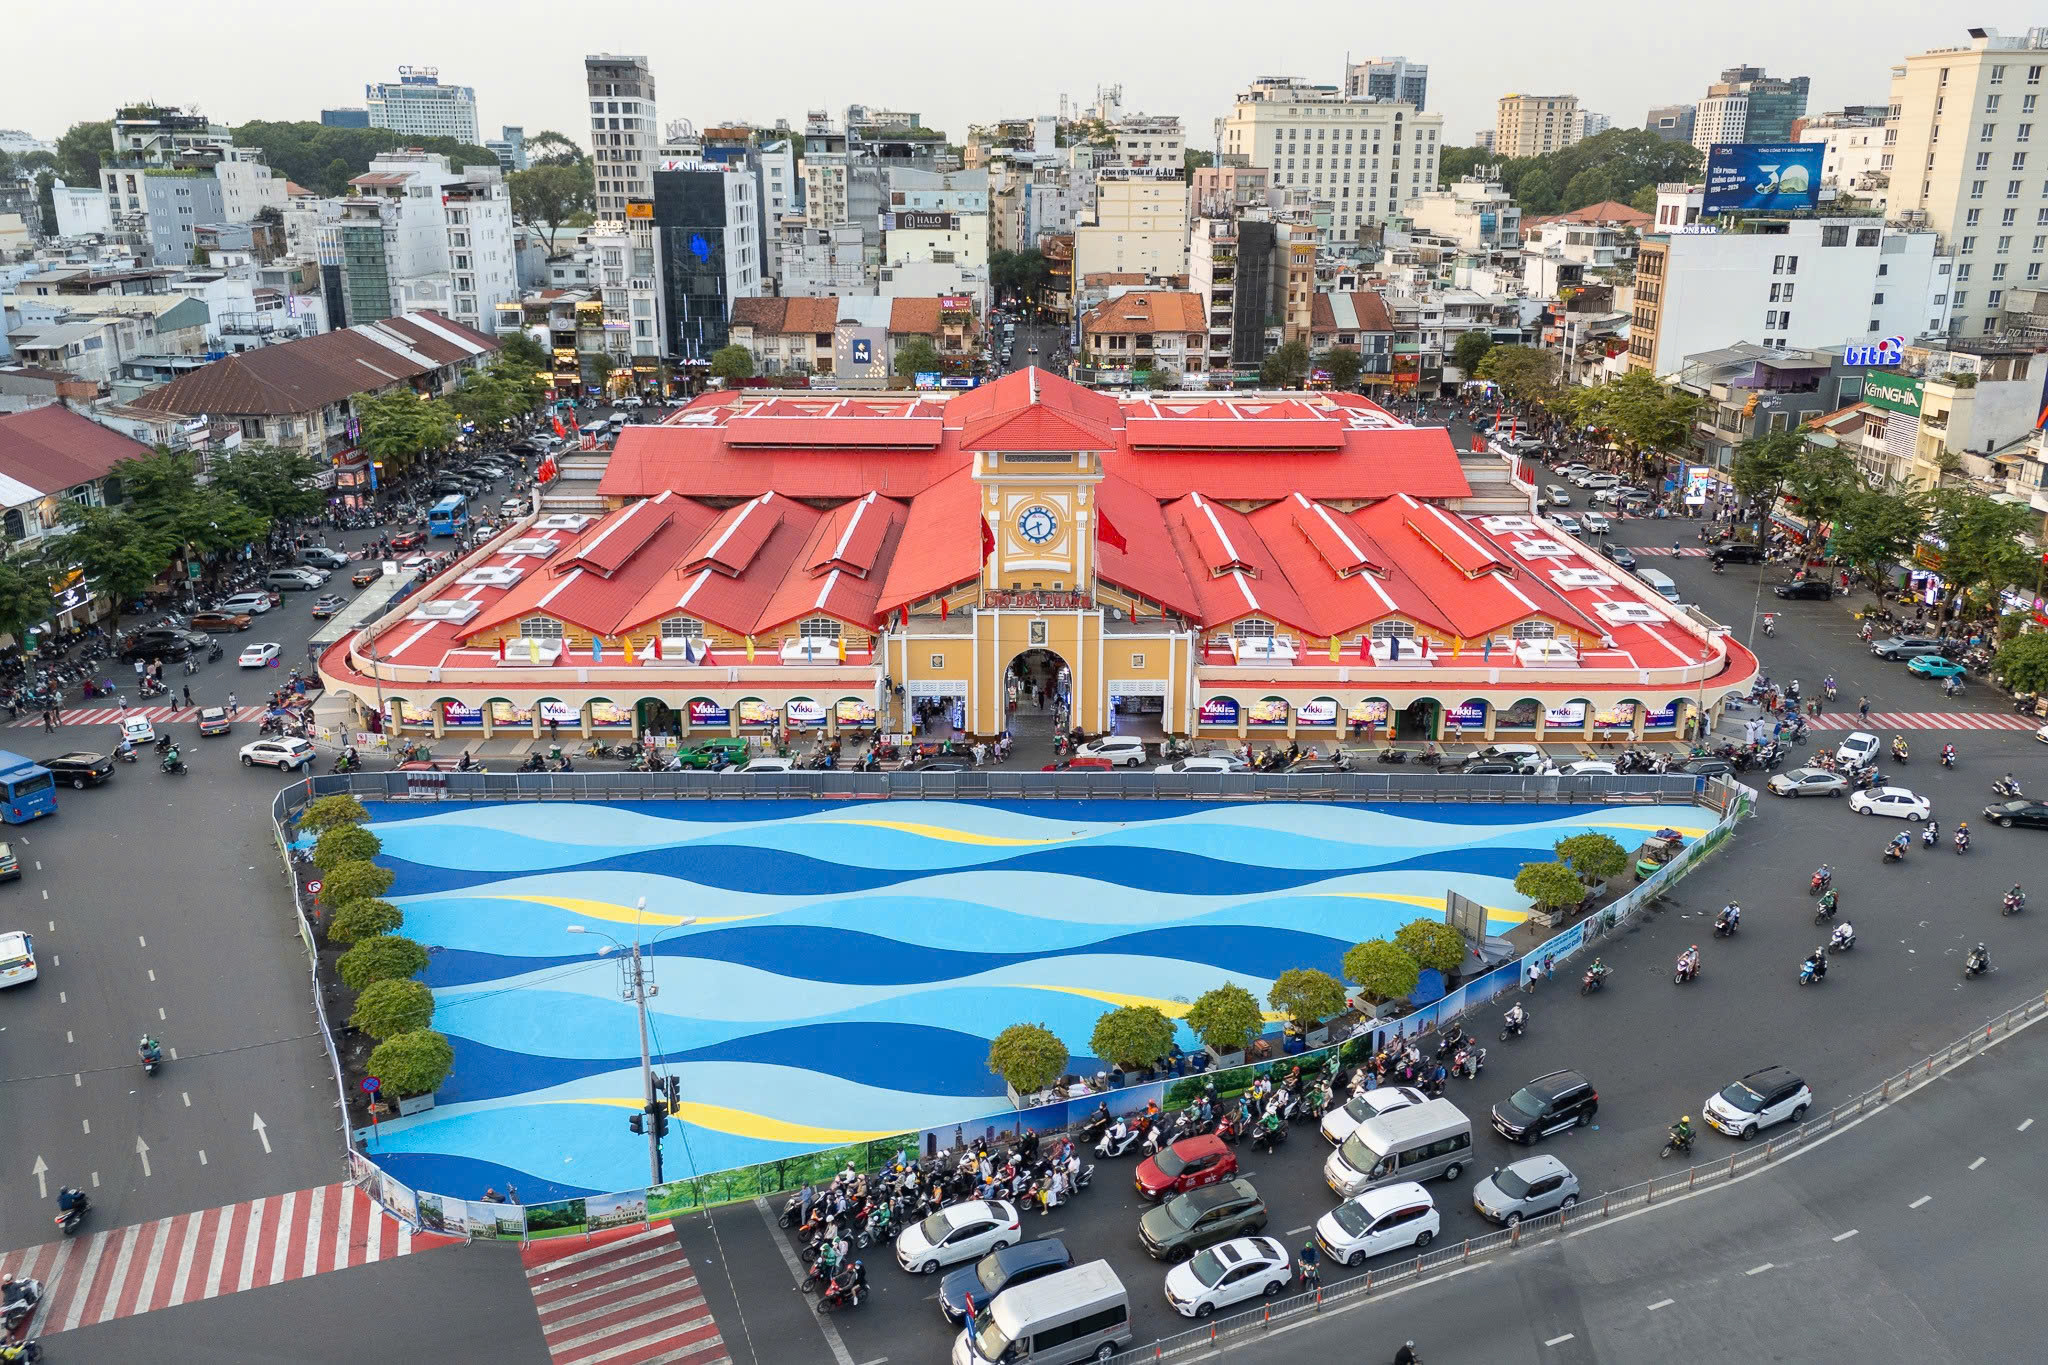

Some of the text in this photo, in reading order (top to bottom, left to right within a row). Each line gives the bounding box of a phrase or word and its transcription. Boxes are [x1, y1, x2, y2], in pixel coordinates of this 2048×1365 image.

[660, 160, 699, 171] AVANTI
[917, 216, 942, 224] HALO
[1700, 226, 1716, 234] BAR
[985, 592, 1091, 608] CHỢ BẾN THÀNH
[544, 702, 567, 714] Vikki
[692, 701, 716, 714] Vikki
[791, 702, 813, 714] Vikki
[1204, 701, 1225, 713] Vikki
